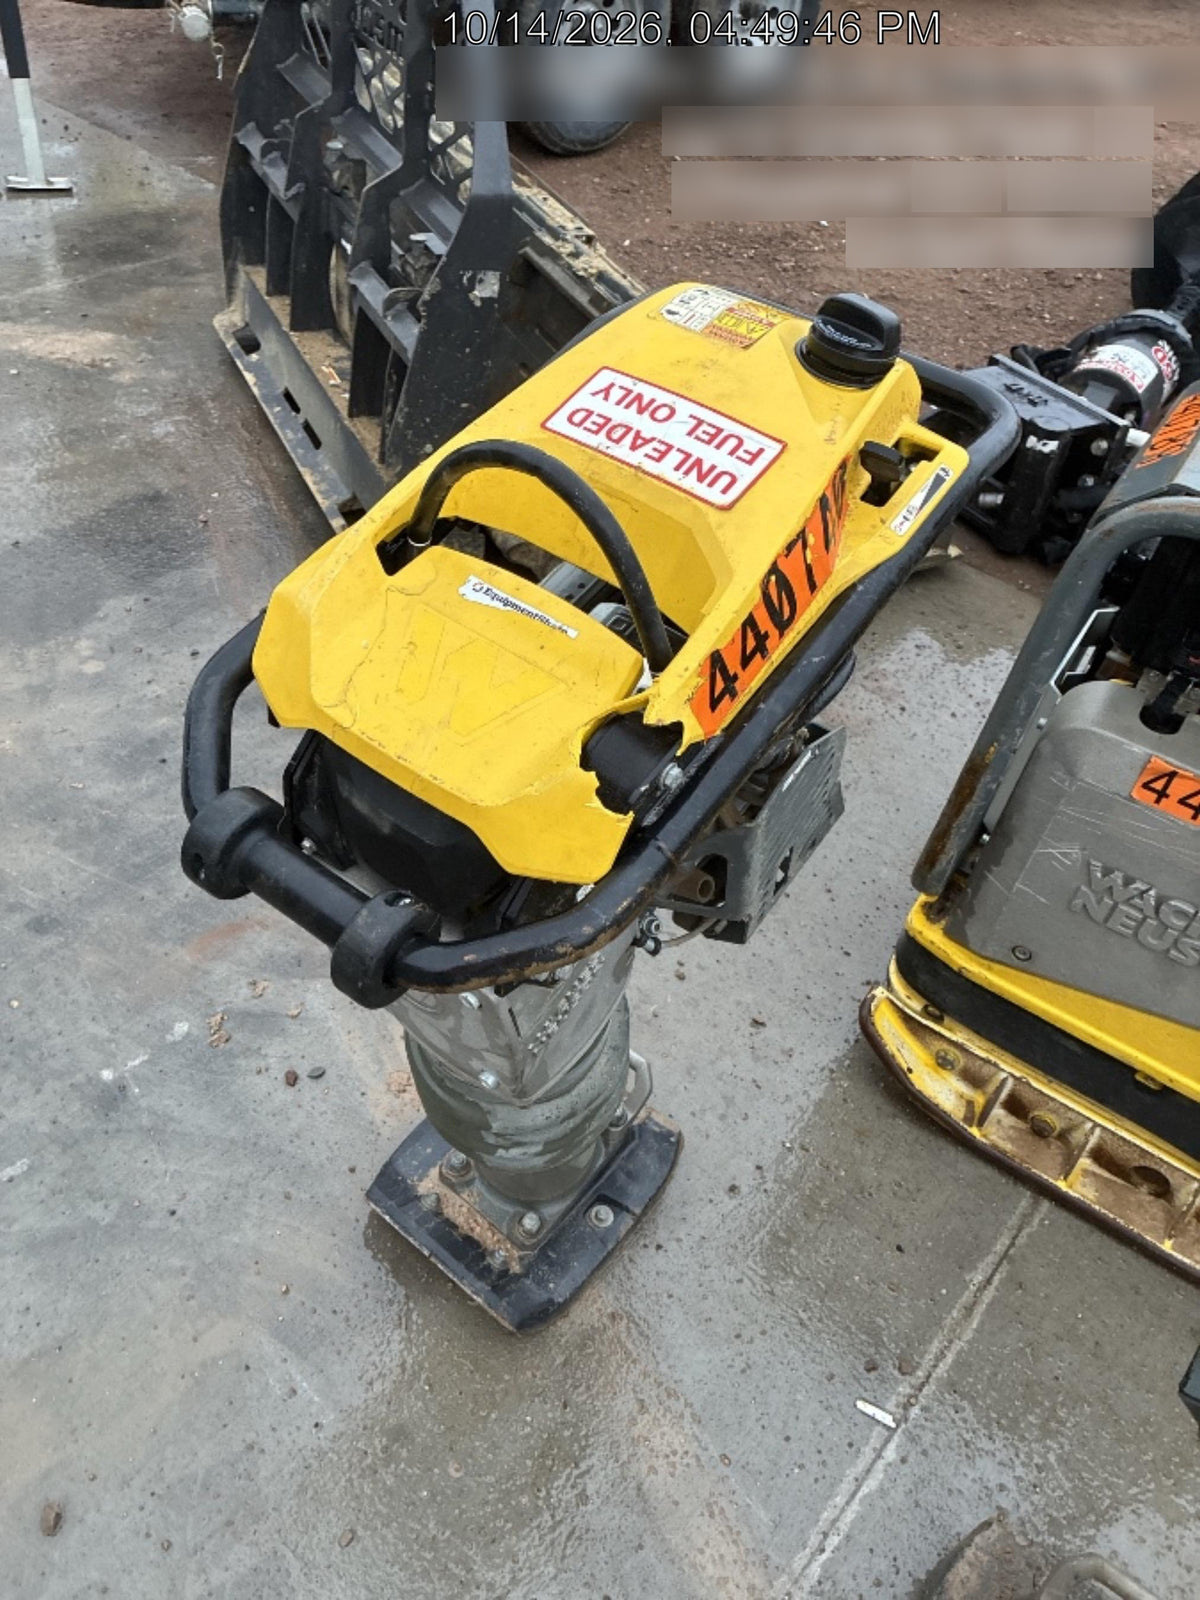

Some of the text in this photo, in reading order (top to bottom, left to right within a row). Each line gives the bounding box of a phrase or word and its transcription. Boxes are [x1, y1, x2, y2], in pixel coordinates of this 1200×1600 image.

[566, 407, 738, 496] UNLEADED
[589, 381, 766, 466] FUEL ONLY
